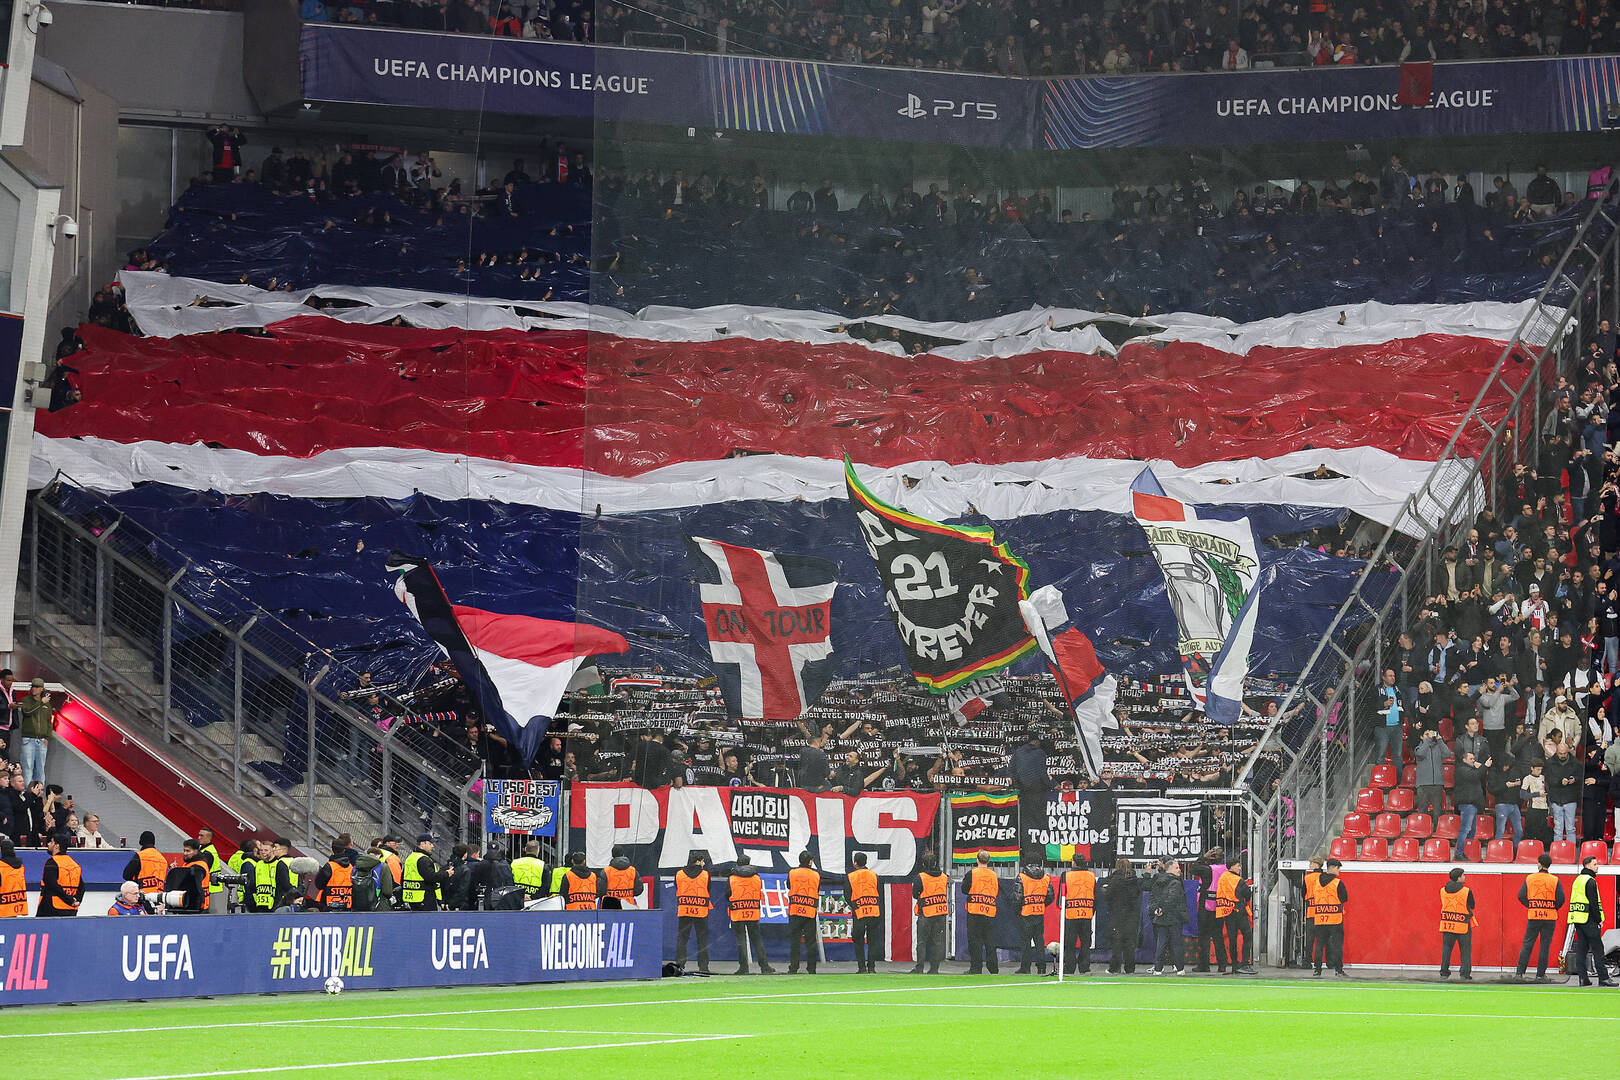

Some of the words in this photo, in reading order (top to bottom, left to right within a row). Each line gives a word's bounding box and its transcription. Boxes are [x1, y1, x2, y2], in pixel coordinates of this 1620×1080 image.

[374, 58, 430, 79] UEFA
[436, 62, 562, 88] CHAMPIONS
[570, 72, 649, 94] LEAGUE
[933, 99, 998, 120] PS5
[1216, 98, 1271, 117] UEFA
[1277, 92, 1402, 115] CHAMPIONS
[1412, 89, 1493, 109] EAGUE
[1176, 531, 1233, 557] GERMAIN
[891, 551, 958, 601] 21
[715, 608, 747, 634] ON
[764, 607, 825, 638] TOUR
[488, 781, 498, 793] LE
[502, 781, 525, 794] PSG
[933, 774, 962, 784] ABDOU
[963, 777, 986, 785] AVEC
[988, 777, 1011, 787] NOUS
[499, 795, 511, 807] LE
[514, 795, 544, 809] PARC
[731, 794, 788, 819] ABDOU
[1046, 800, 1091, 816] KAMA
[732, 821, 758, 835] AVEC
[955, 826, 1017, 841] FOREVER
[957, 813, 1010, 833] COULY
[1048, 815, 1088, 831] POUR
[1118, 811, 1201, 836] LIBEREZ
[1028, 828, 1110, 845] TOUJOURS
[1117, 837, 1134, 855] LE
[121, 933, 194, 982] UEFA
[270, 925, 373, 981] #FOOTBALL
[430, 927, 489, 971] UEFA
